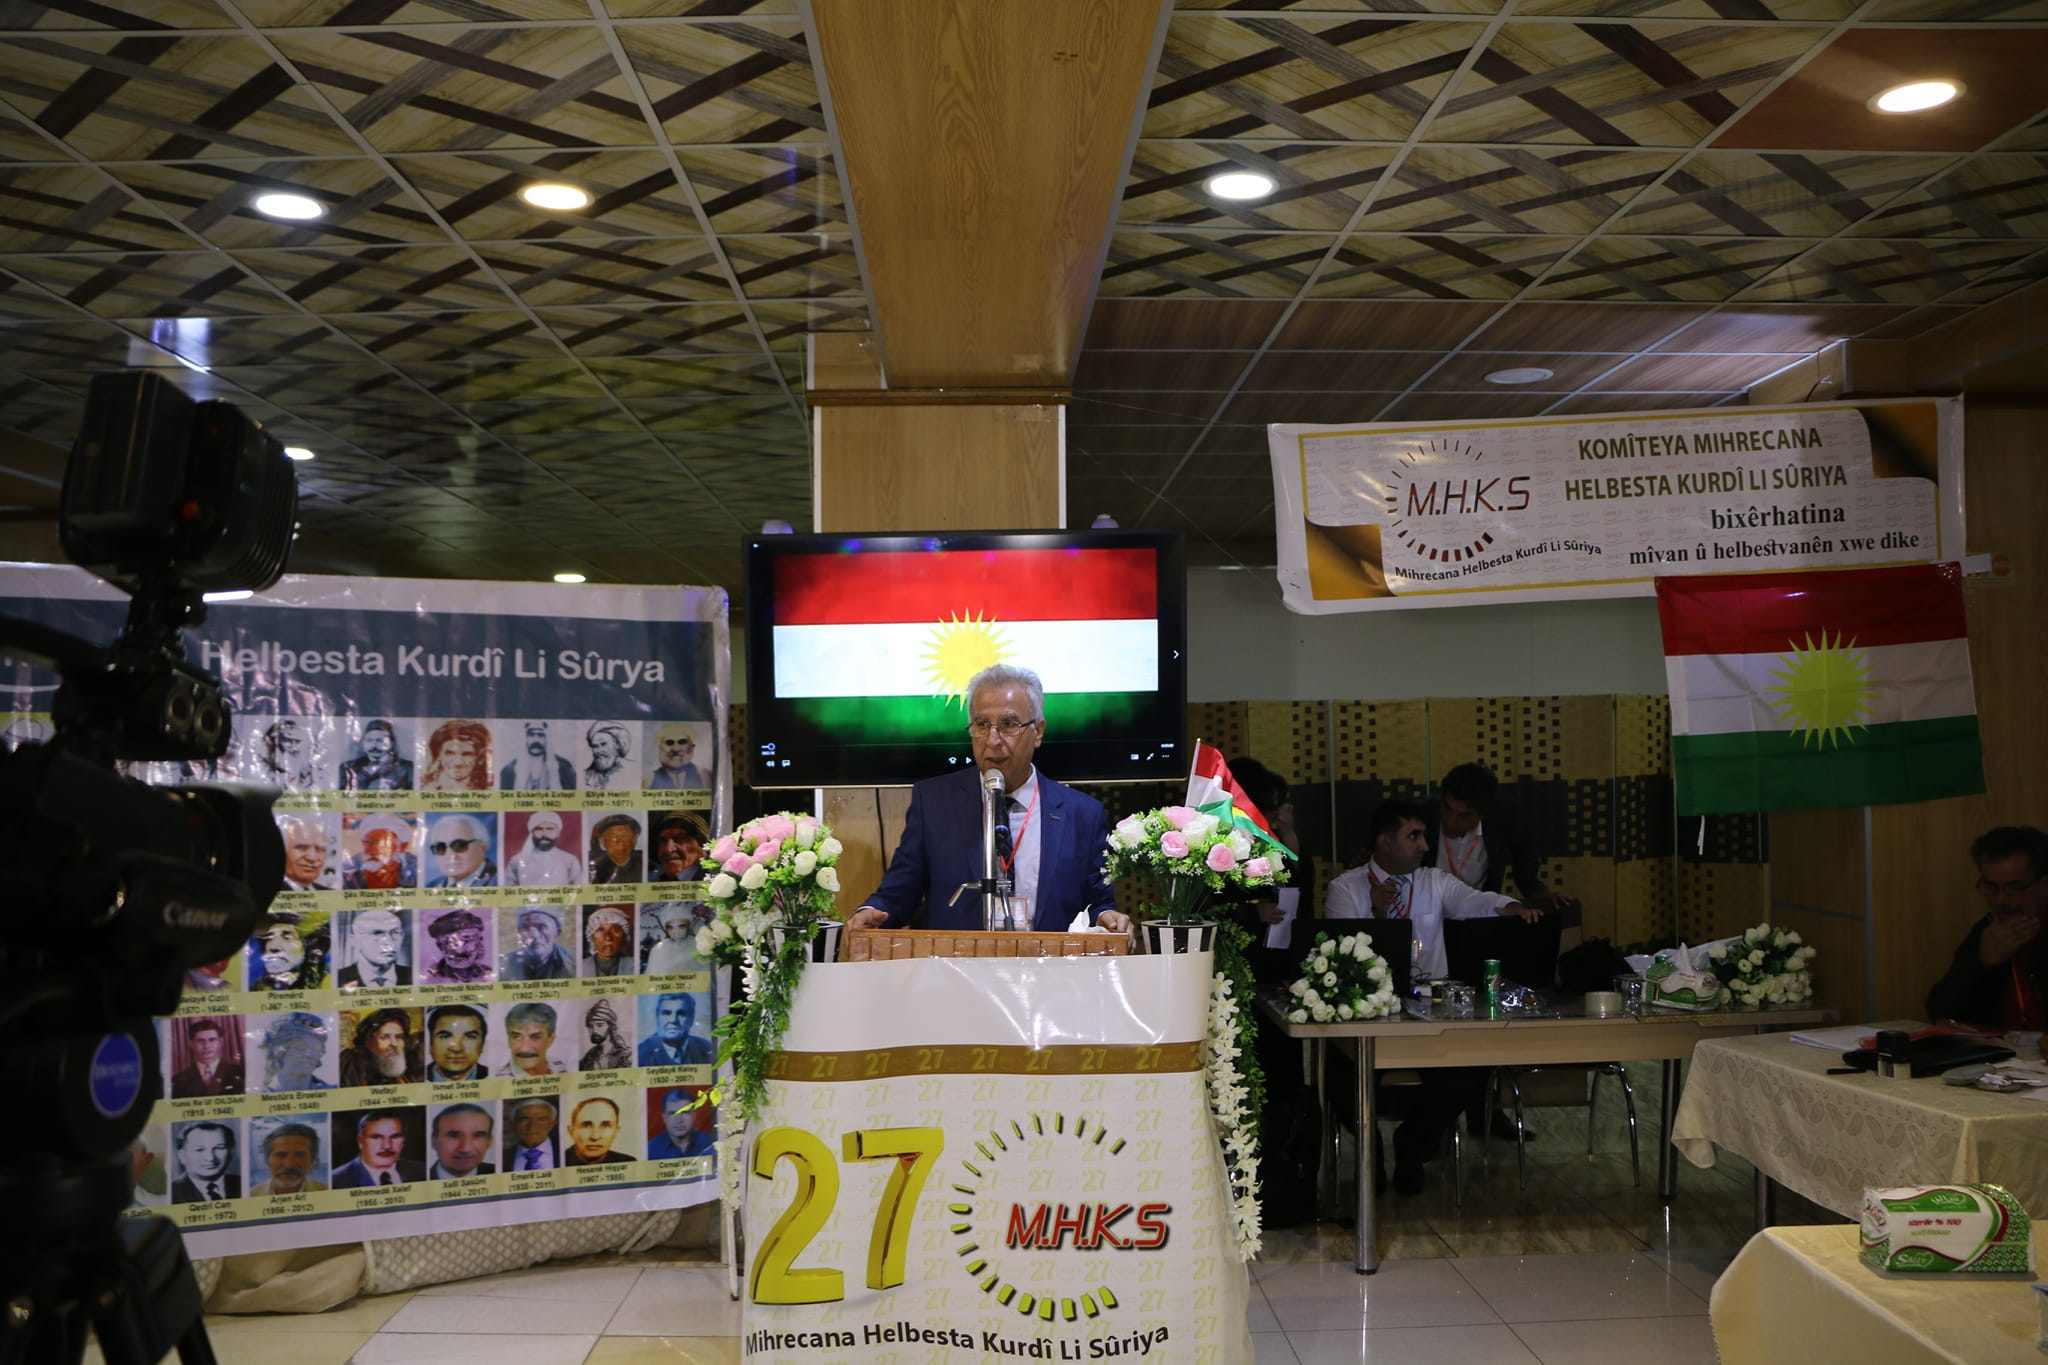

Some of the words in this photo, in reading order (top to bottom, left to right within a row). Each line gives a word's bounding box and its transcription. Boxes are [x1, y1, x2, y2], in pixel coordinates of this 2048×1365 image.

[1579, 433, 1688, 460] KOMÎTEYA
[1694, 428, 1823, 453] MIHRECANA
[1407, 476, 1530, 516] M.H.K.S
[1565, 474, 1672, 501] HELBESTA
[1677, 467, 1744, 495] KURDÎ
[1750, 469, 1766, 490] LI
[1773, 463, 1847, 488] SÛRIYA
[1711, 503, 1845, 530] bixêrhatina
[1395, 566, 1460, 581] Mihrecana
[1462, 555, 1513, 575] Helbesta
[1515, 543, 1548, 559] Kurdî
[1551, 540, 1561, 552] Li
[1563, 540, 1602, 555] Sûriya
[1630, 546, 1688, 565] mîvan
[1696, 543, 1706, 561] û
[1714, 536, 1834, 561] helbestvanên
[1839, 536, 1875, 551] xwe
[1880, 531, 1919, 550] dike
[201, 640, 384, 676] Helbesta
[398, 645, 504, 678] Kurdî
[515, 648, 545, 680] Li
[558, 650, 665, 688] Sûrya
[770, 1055, 788, 1075] 27
[811, 1056, 837, 1078] 27
[865, 1052, 891, 1075] 27
[918, 1049, 944, 1071] 27
[972, 1049, 998, 1070] 27
[1025, 1049, 1052, 1071] 27
[1080, 1049, 1107, 1070] 27
[1136, 1048, 1162, 1070] 27
[812, 1087, 837, 1109] 27
[865, 1084, 891, 1107] 27
[918, 1080, 944, 1102] 27
[972, 1080, 998, 1101] 27
[1025, 1080, 1052, 1101] 27
[1080, 1080, 1107, 1100] 27
[1136, 1080, 1162, 1100] 27
[751, 1126, 945, 1304] 27
[1006, 1203, 1171, 1249] M.H.K.S
[746, 1327, 855, 1356] Mihrecana
[864, 1322, 974, 1349] Helbesta
[983, 1331, 1052, 1360] Kurdî
[1060, 1340, 1080, 1360] Li
[1090, 1326, 1169, 1359] Sûriya
